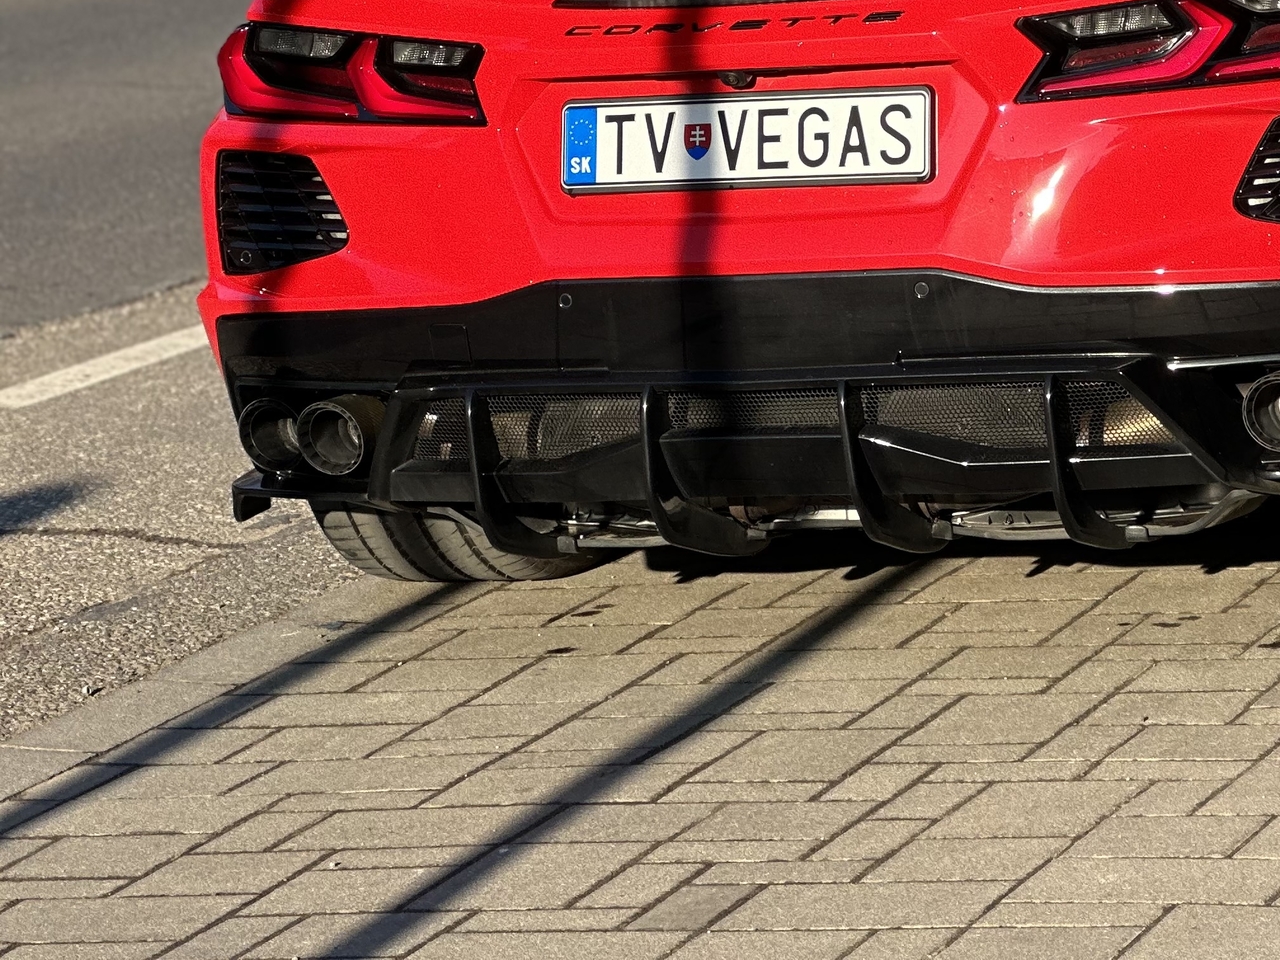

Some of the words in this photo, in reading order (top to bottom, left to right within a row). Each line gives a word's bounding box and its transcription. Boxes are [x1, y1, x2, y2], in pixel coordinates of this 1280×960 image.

[564, 10, 905, 37] CORVETTE
[604, 112, 676, 175] TV
[717, 104, 912, 171] VEGAS
[570, 157, 592, 175] SK
